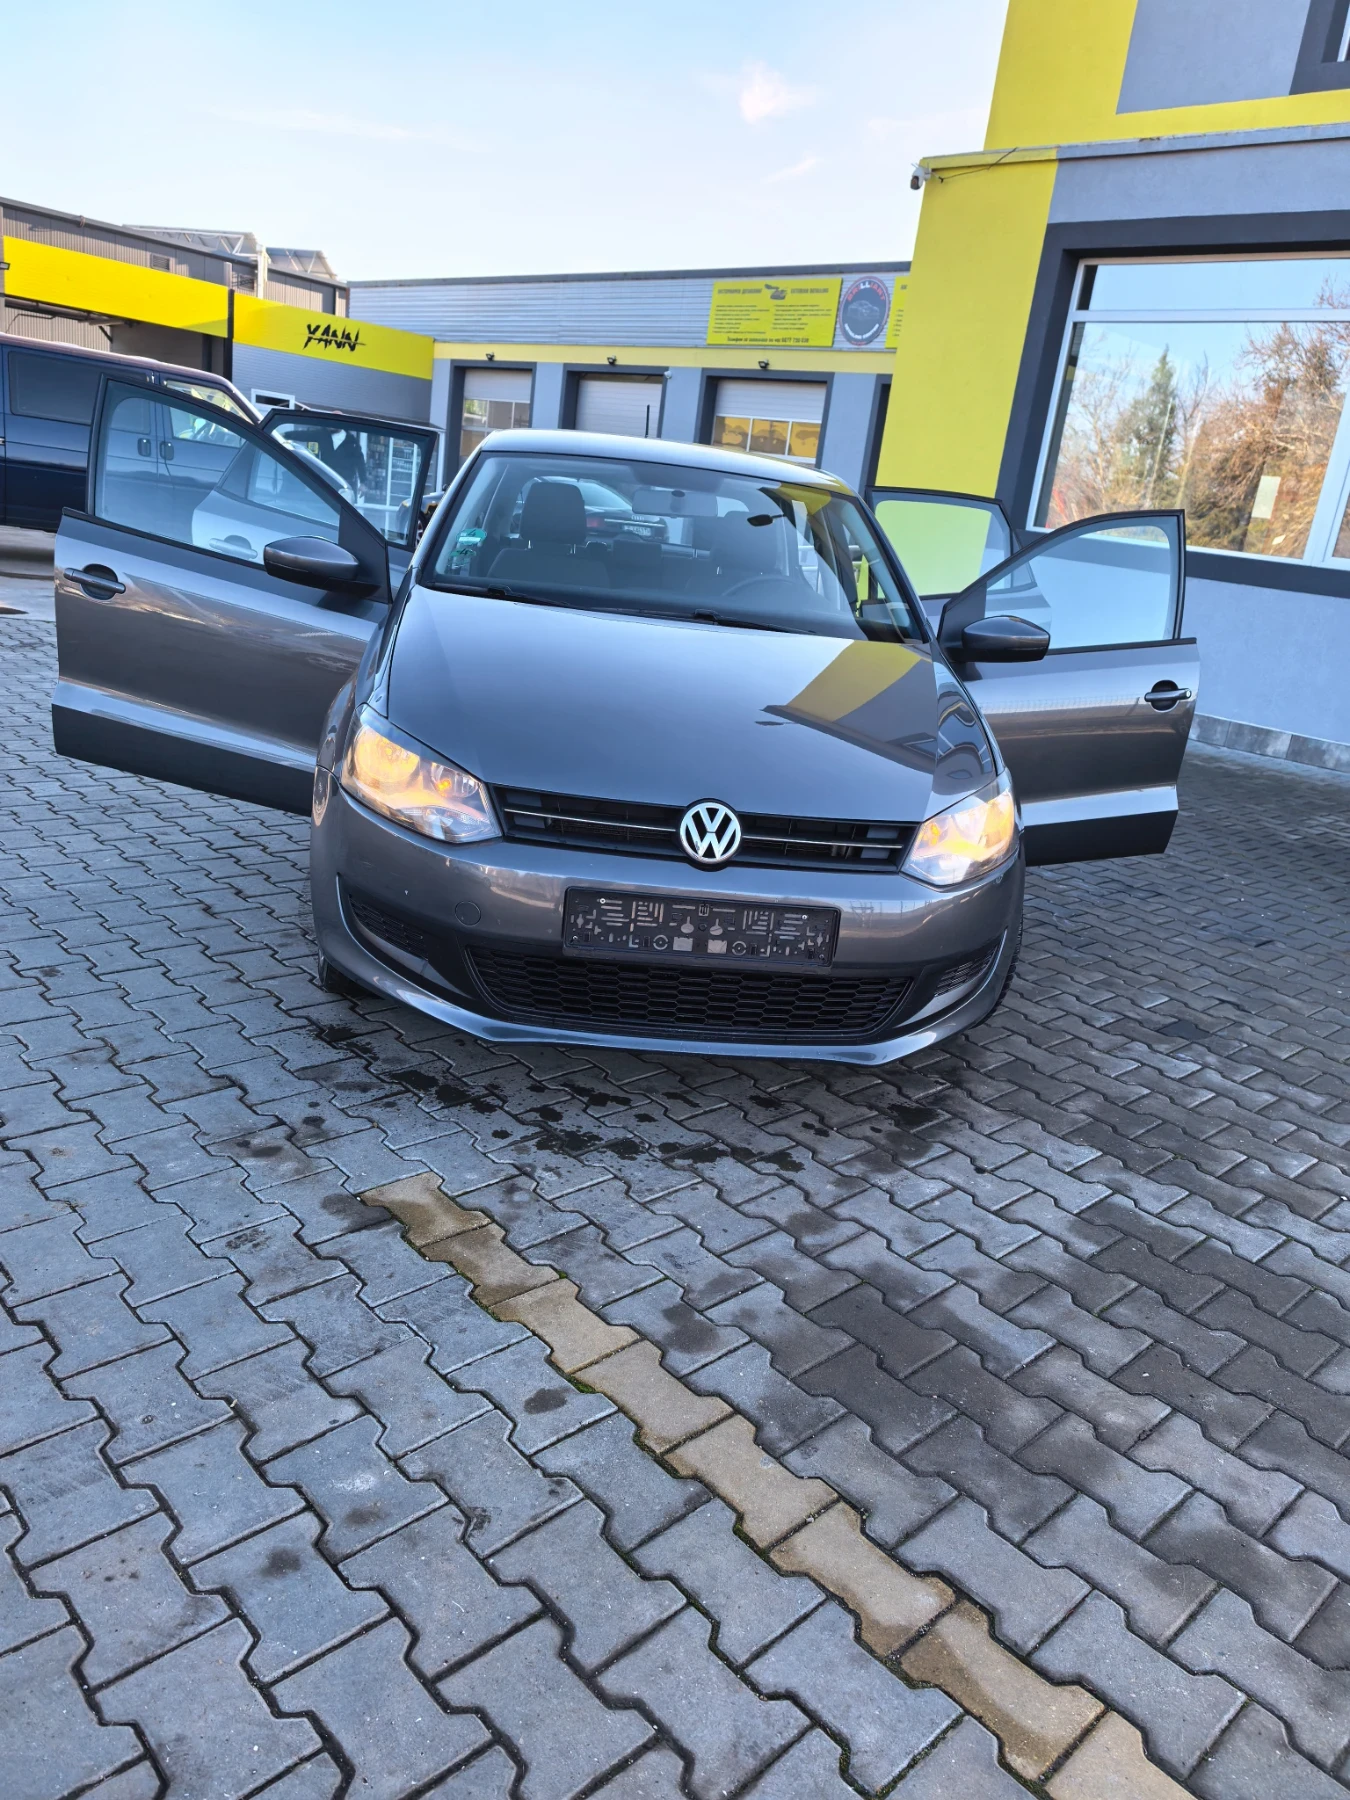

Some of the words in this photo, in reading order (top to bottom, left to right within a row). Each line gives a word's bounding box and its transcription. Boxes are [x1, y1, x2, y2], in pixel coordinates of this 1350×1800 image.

[847, 282, 885, 301] BRILLIANT
[303, 324, 364, 351] YANN
[459, 548, 469, 556] 4
[680, 802, 741, 864] VW
